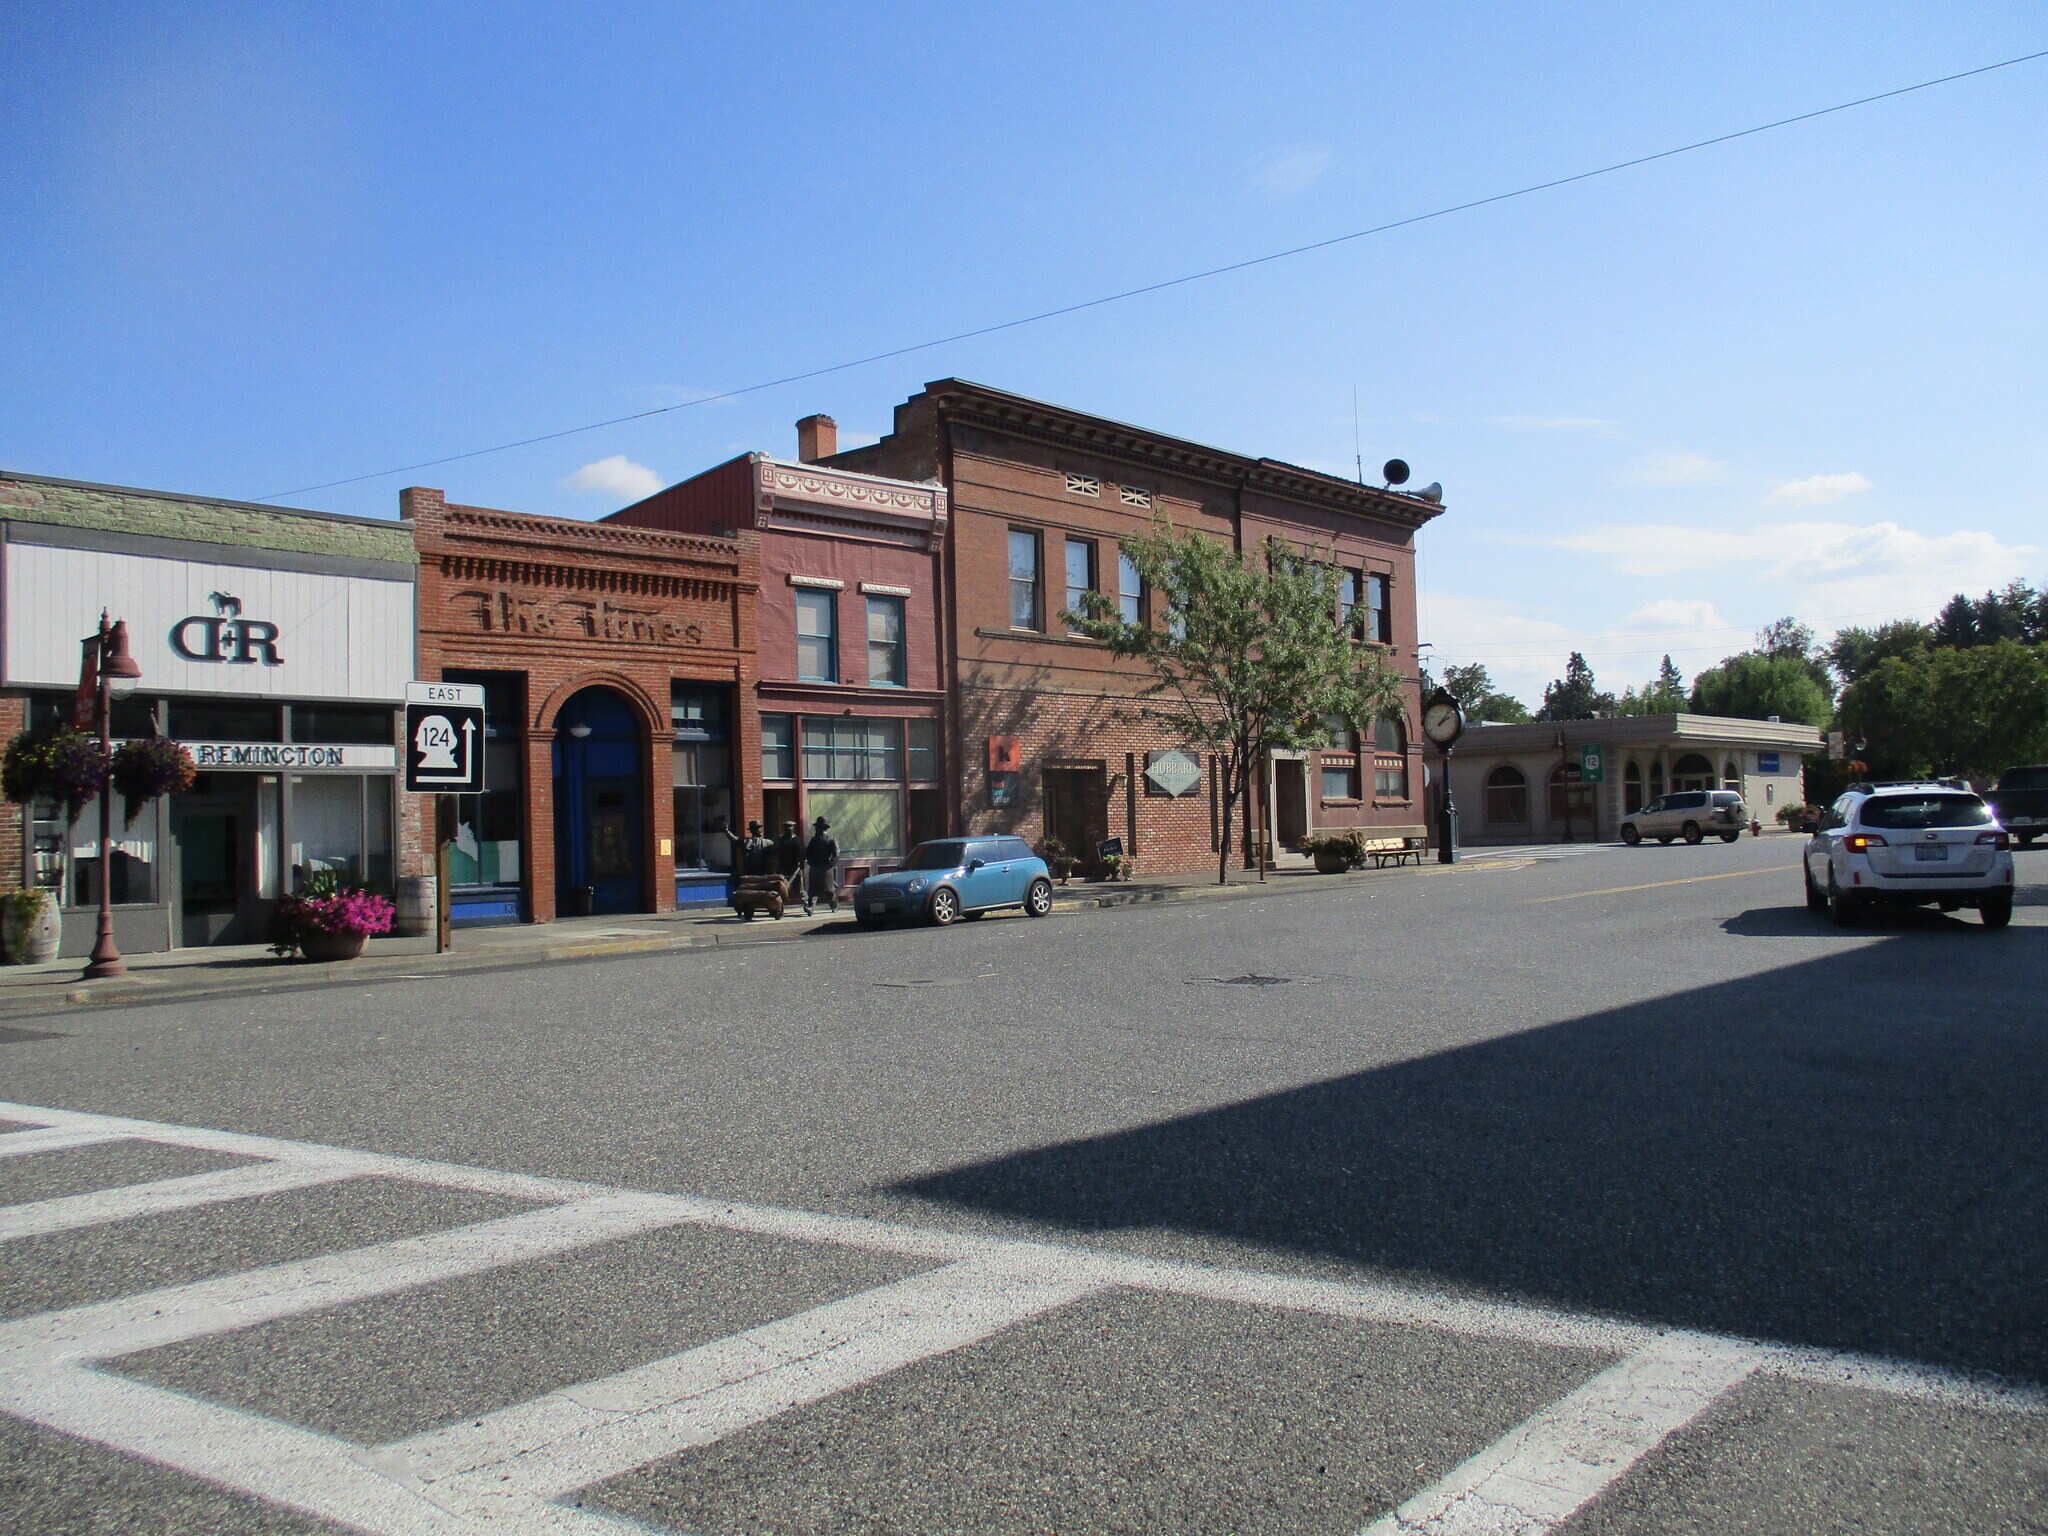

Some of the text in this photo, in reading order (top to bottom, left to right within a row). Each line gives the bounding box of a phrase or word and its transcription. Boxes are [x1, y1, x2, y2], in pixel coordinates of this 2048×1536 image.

[450, 585, 709, 644] The Times
[428, 687, 462, 701] EAST
[423, 727, 450, 747] 124
[199, 745, 344, 766] REMINGTON
[1587, 757, 1597, 767] 12
[1151, 762, 1197, 775] HUBBARD
